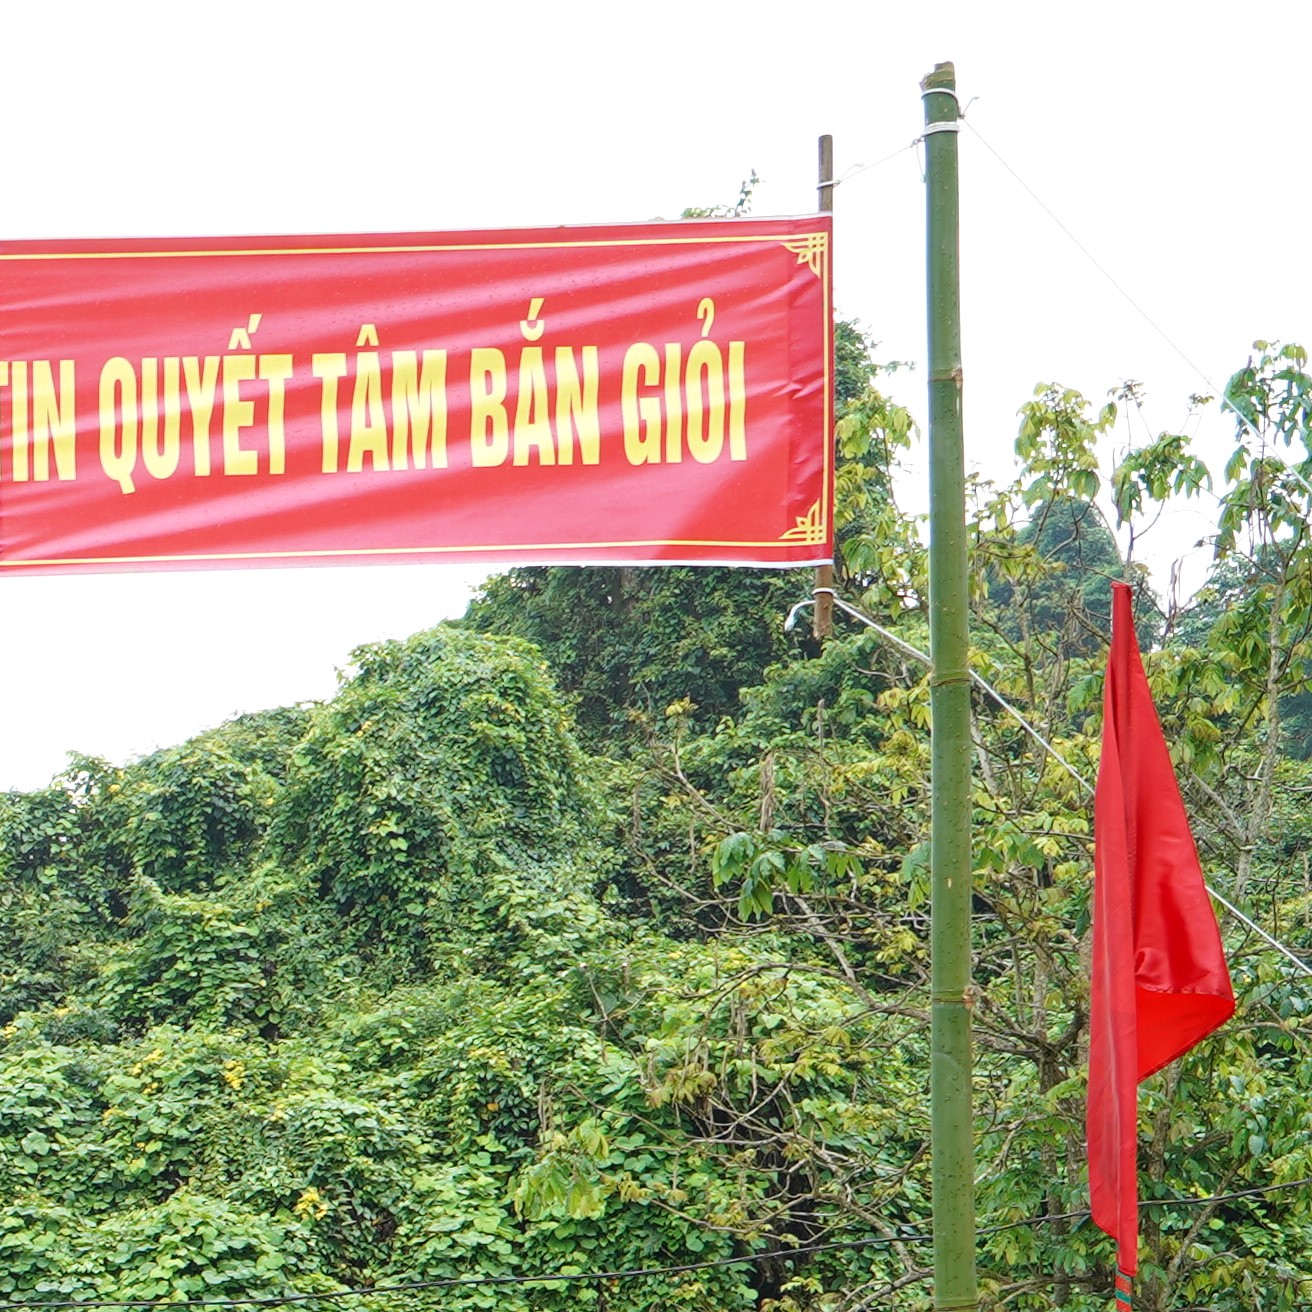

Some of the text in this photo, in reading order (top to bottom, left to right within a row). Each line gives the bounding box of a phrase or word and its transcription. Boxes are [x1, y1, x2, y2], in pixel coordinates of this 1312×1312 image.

[99, 313, 296, 495] QUYẾT
[312, 324, 449, 473] TÂM
[470, 297, 602, 469] BẮN
[622, 297, 747, 465] GIỎI
